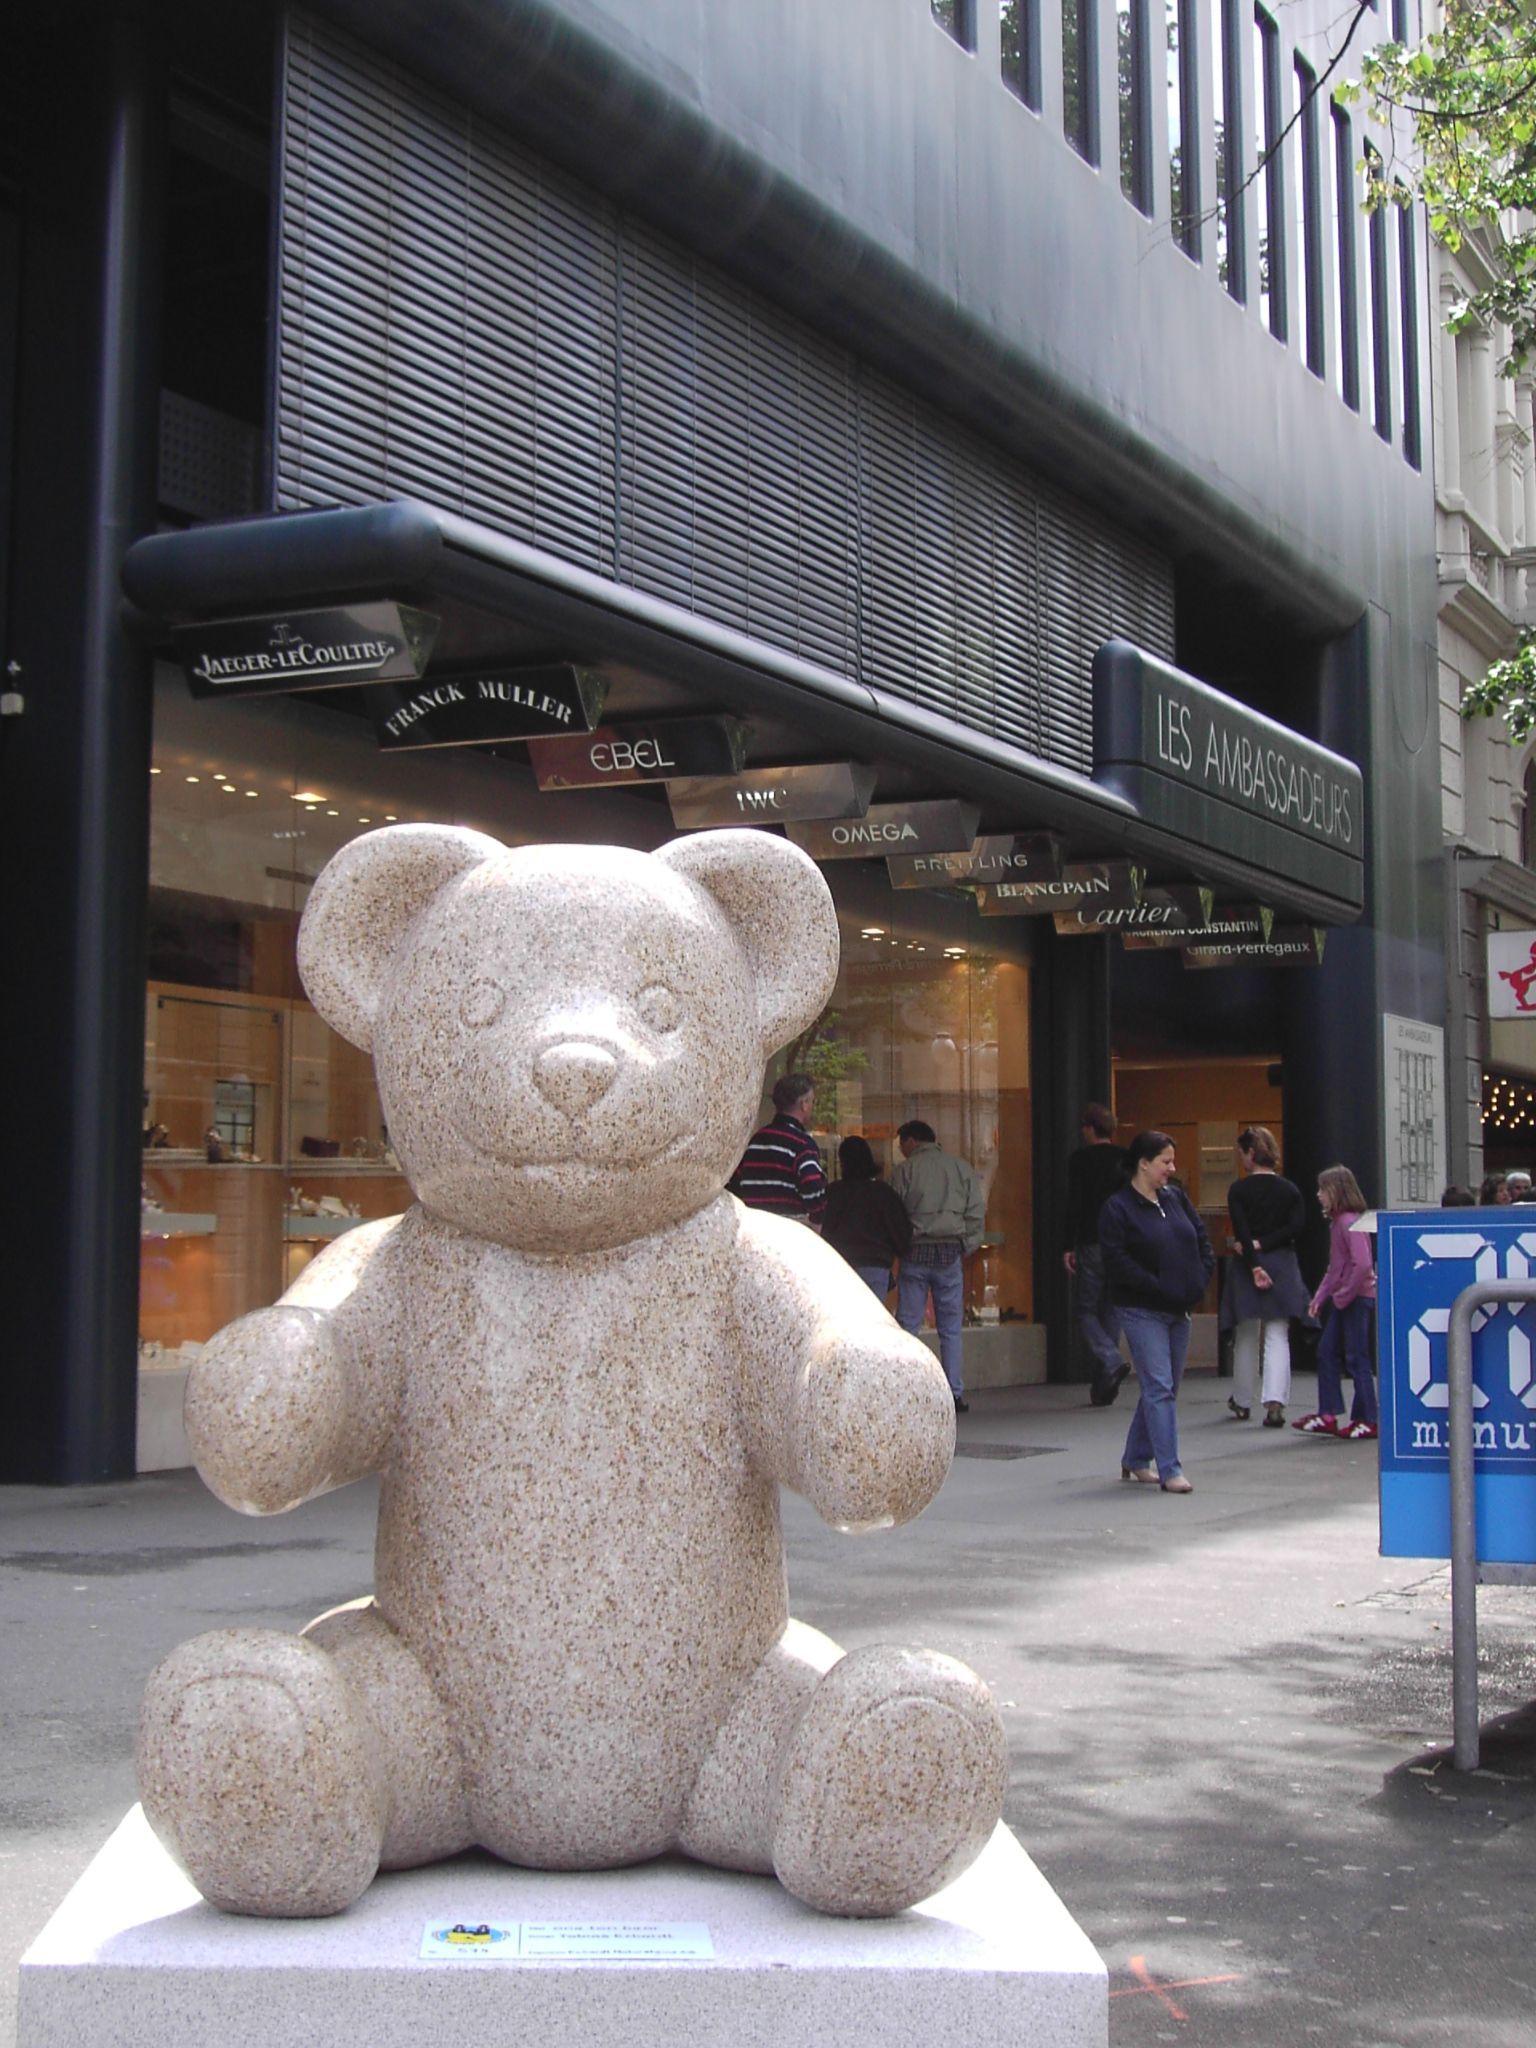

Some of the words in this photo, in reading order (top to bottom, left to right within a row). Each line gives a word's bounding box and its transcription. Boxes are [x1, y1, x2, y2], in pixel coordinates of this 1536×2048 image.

[385, 682, 465, 737] FRANCK
[477, 680, 573, 724] MULLER
[590, 739, 676, 771] EBEL
[1157, 693, 1193, 771] LES
[1203, 720, 1352, 843] AMBASSADEURS
[831, 822, 919, 845] OMEGA
[996, 877, 1111, 898] BLANCPAIN
[1411, 1420, 1536, 1449] mnu
